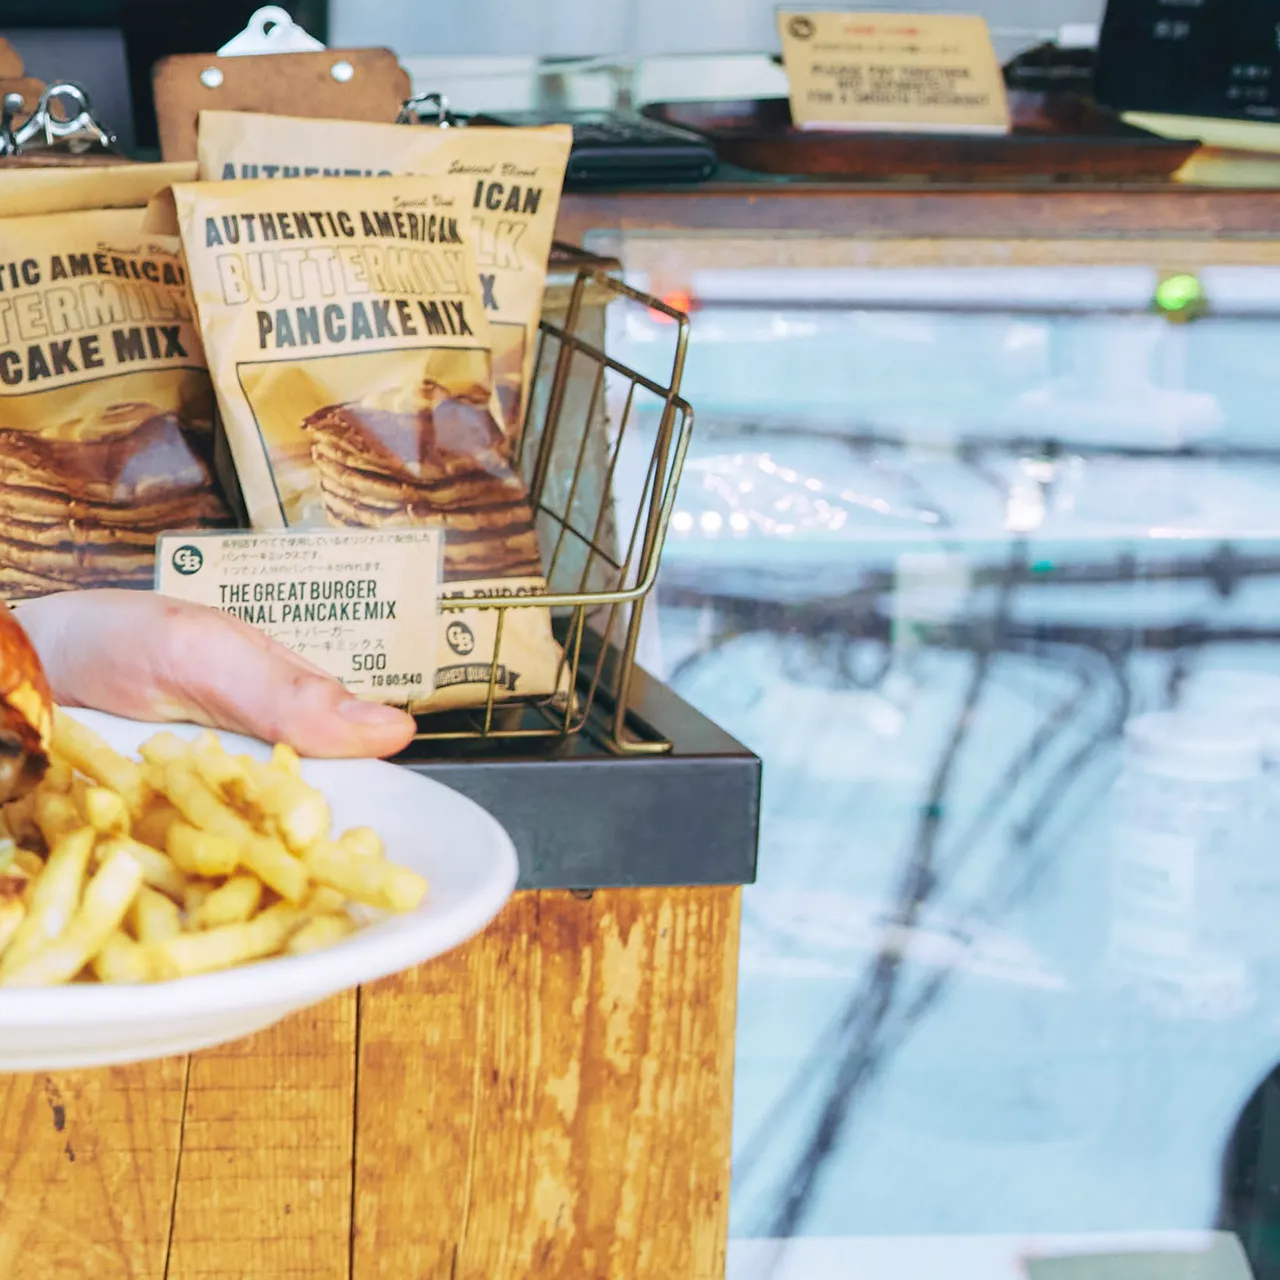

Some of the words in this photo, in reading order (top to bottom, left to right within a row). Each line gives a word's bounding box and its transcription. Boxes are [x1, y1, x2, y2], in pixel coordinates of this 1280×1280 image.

[473, 180, 542, 214] ICAN
[205, 209, 355, 247] AUTHENTIC
[359, 210, 464, 245] AMERICAN
[255, 299, 418, 350] PANCAKE
[417, 300, 475, 337] MIX
[112, 325, 189, 363] MIX
[174, 548, 202, 572] GB
[219, 583, 250, 603] THE
[253, 581, 307, 602] GREAT
[310, 579, 377, 601] BURGER
[282, 602, 364, 622] PANCAKE
[364, 600, 397, 621] MIX
[285, 639, 385, 653] ンケーキミックス
[352, 653, 386, 671] 500
